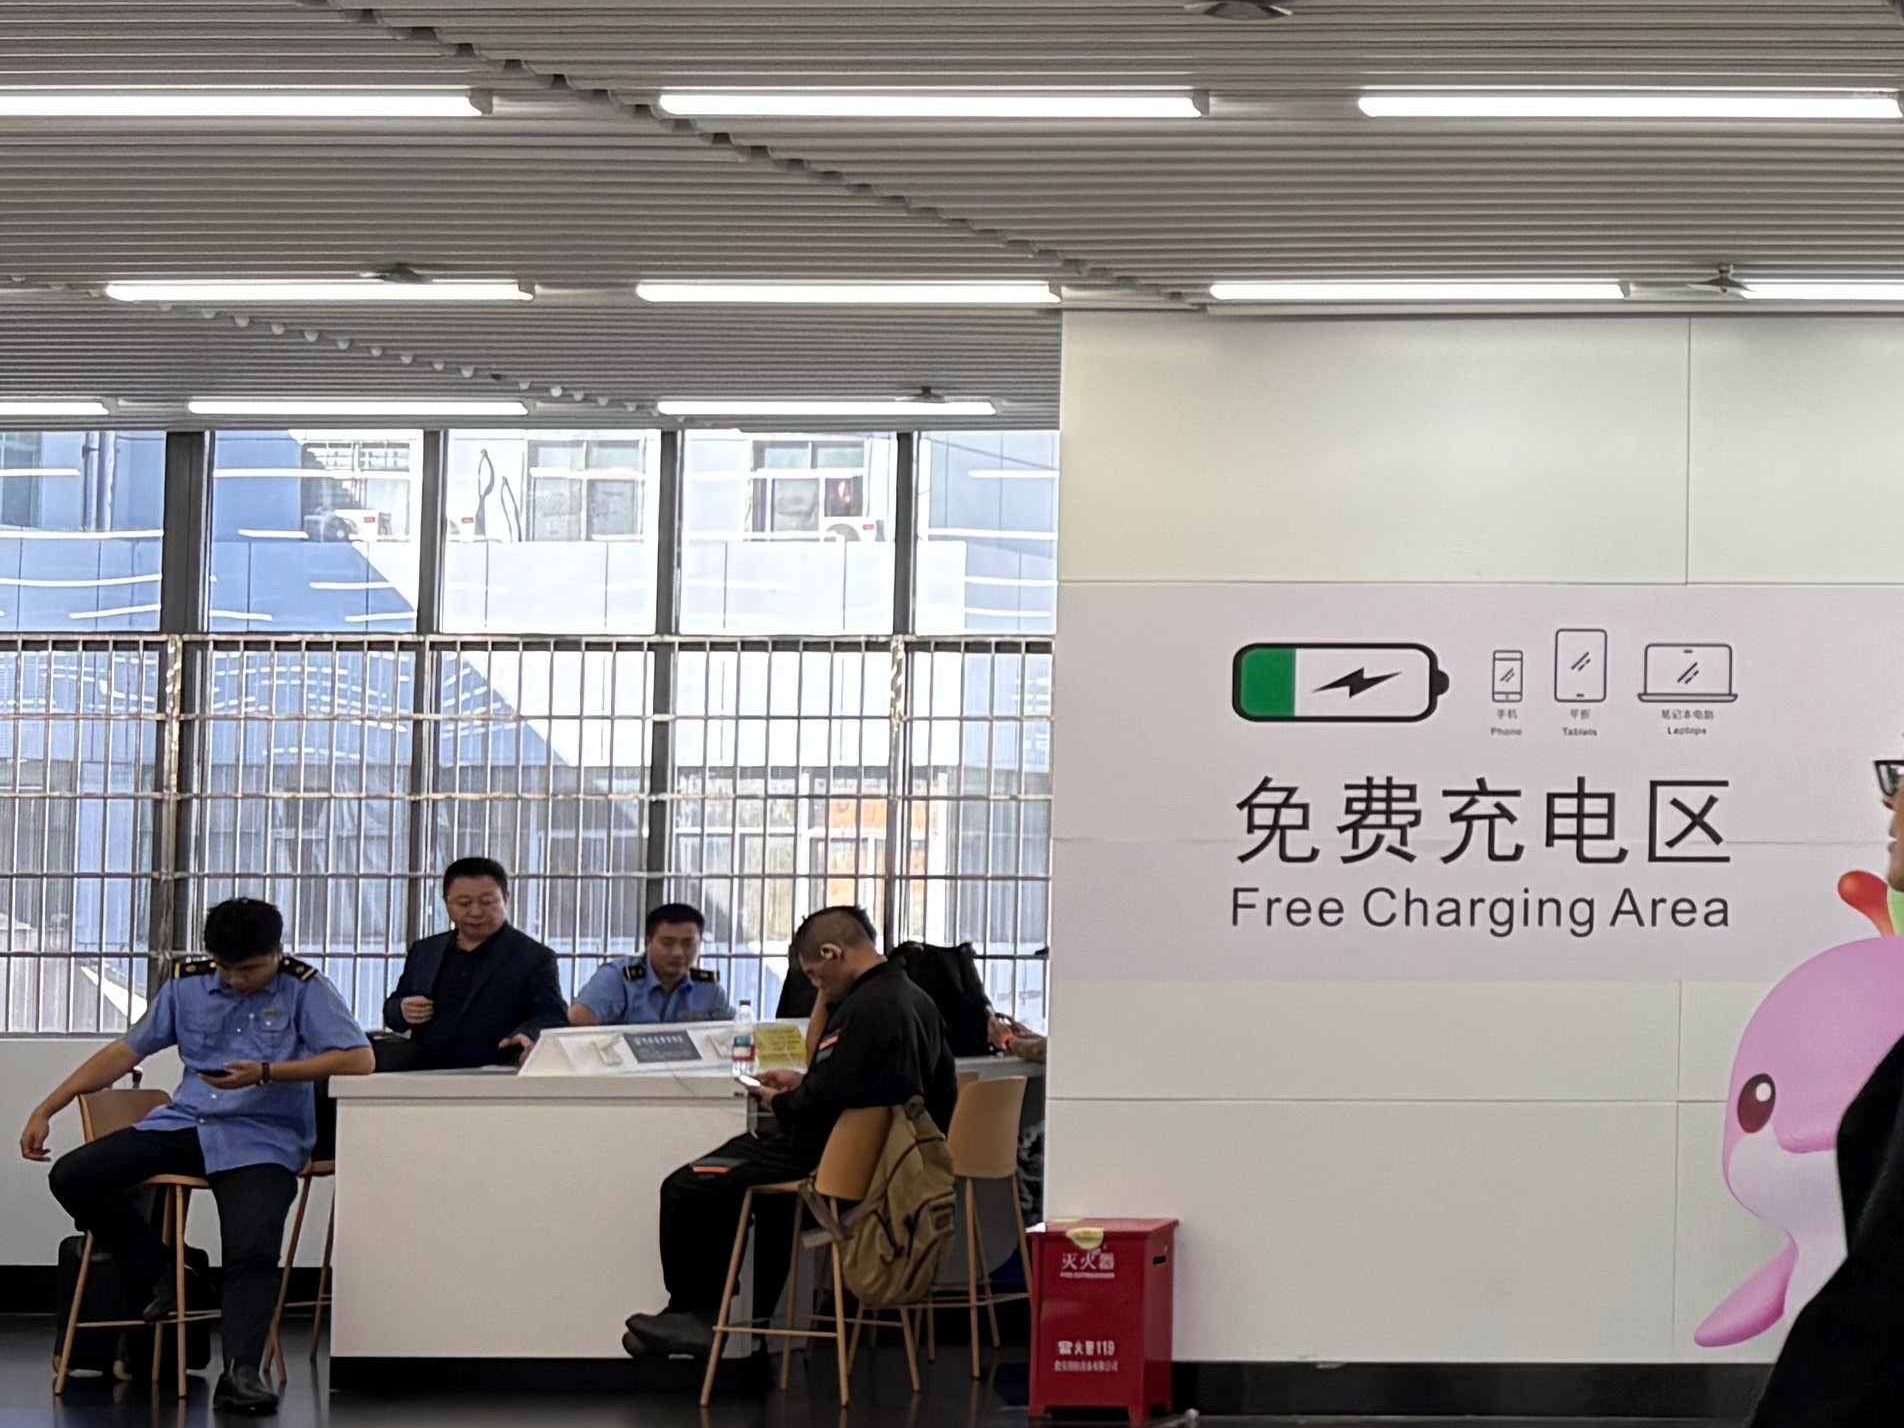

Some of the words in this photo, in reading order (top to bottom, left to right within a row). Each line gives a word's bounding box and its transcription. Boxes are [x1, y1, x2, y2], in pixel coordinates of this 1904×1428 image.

[1235, 774, 1731, 864] 免费充电区
[1232, 887, 1344, 927] Free
[1362, 887, 1597, 937] Charging
[1610, 887, 1731, 927] Area
[1062, 1252, 1114, 1269] 灭火器
